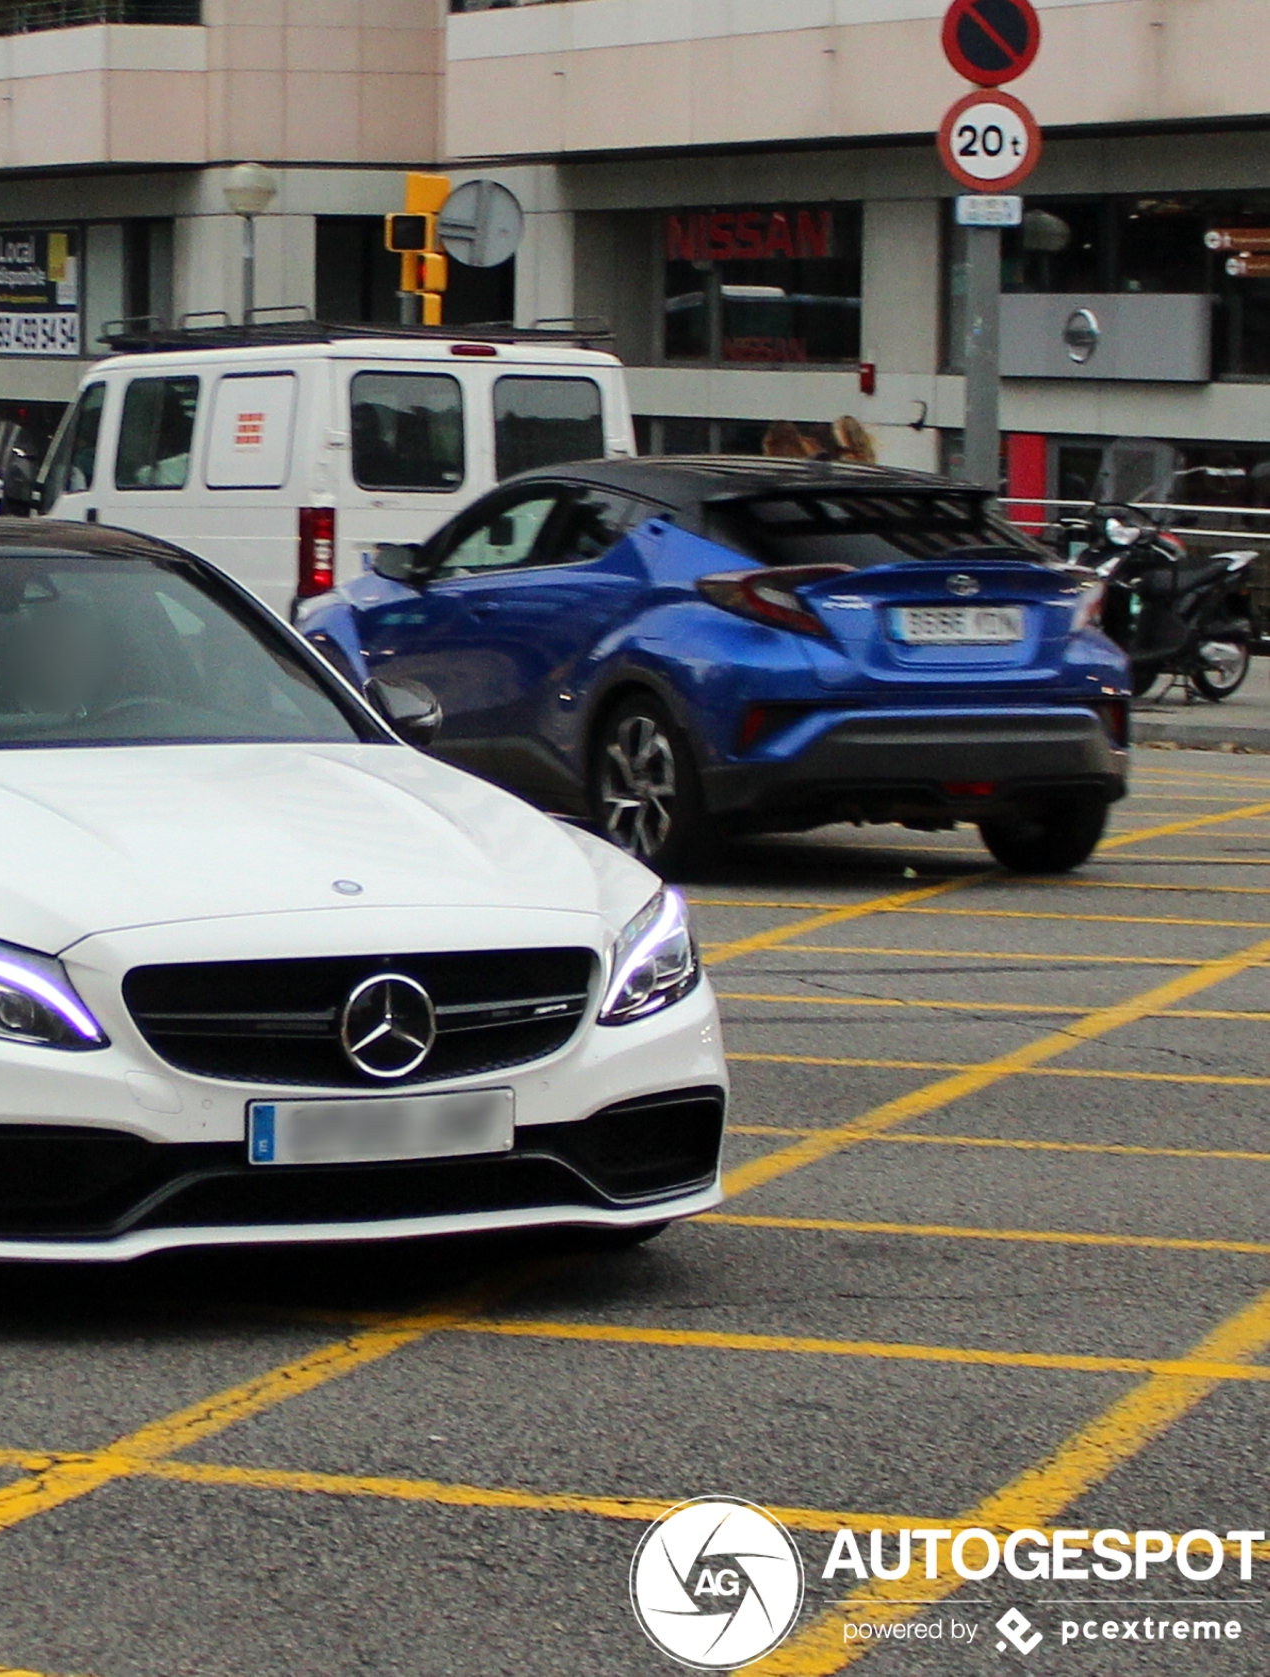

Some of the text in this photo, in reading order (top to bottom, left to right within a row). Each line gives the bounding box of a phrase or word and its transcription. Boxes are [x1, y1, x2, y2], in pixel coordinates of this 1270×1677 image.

[958, 124, 1023, 157] 20 t
[666, 210, 831, 261] NISSAN
